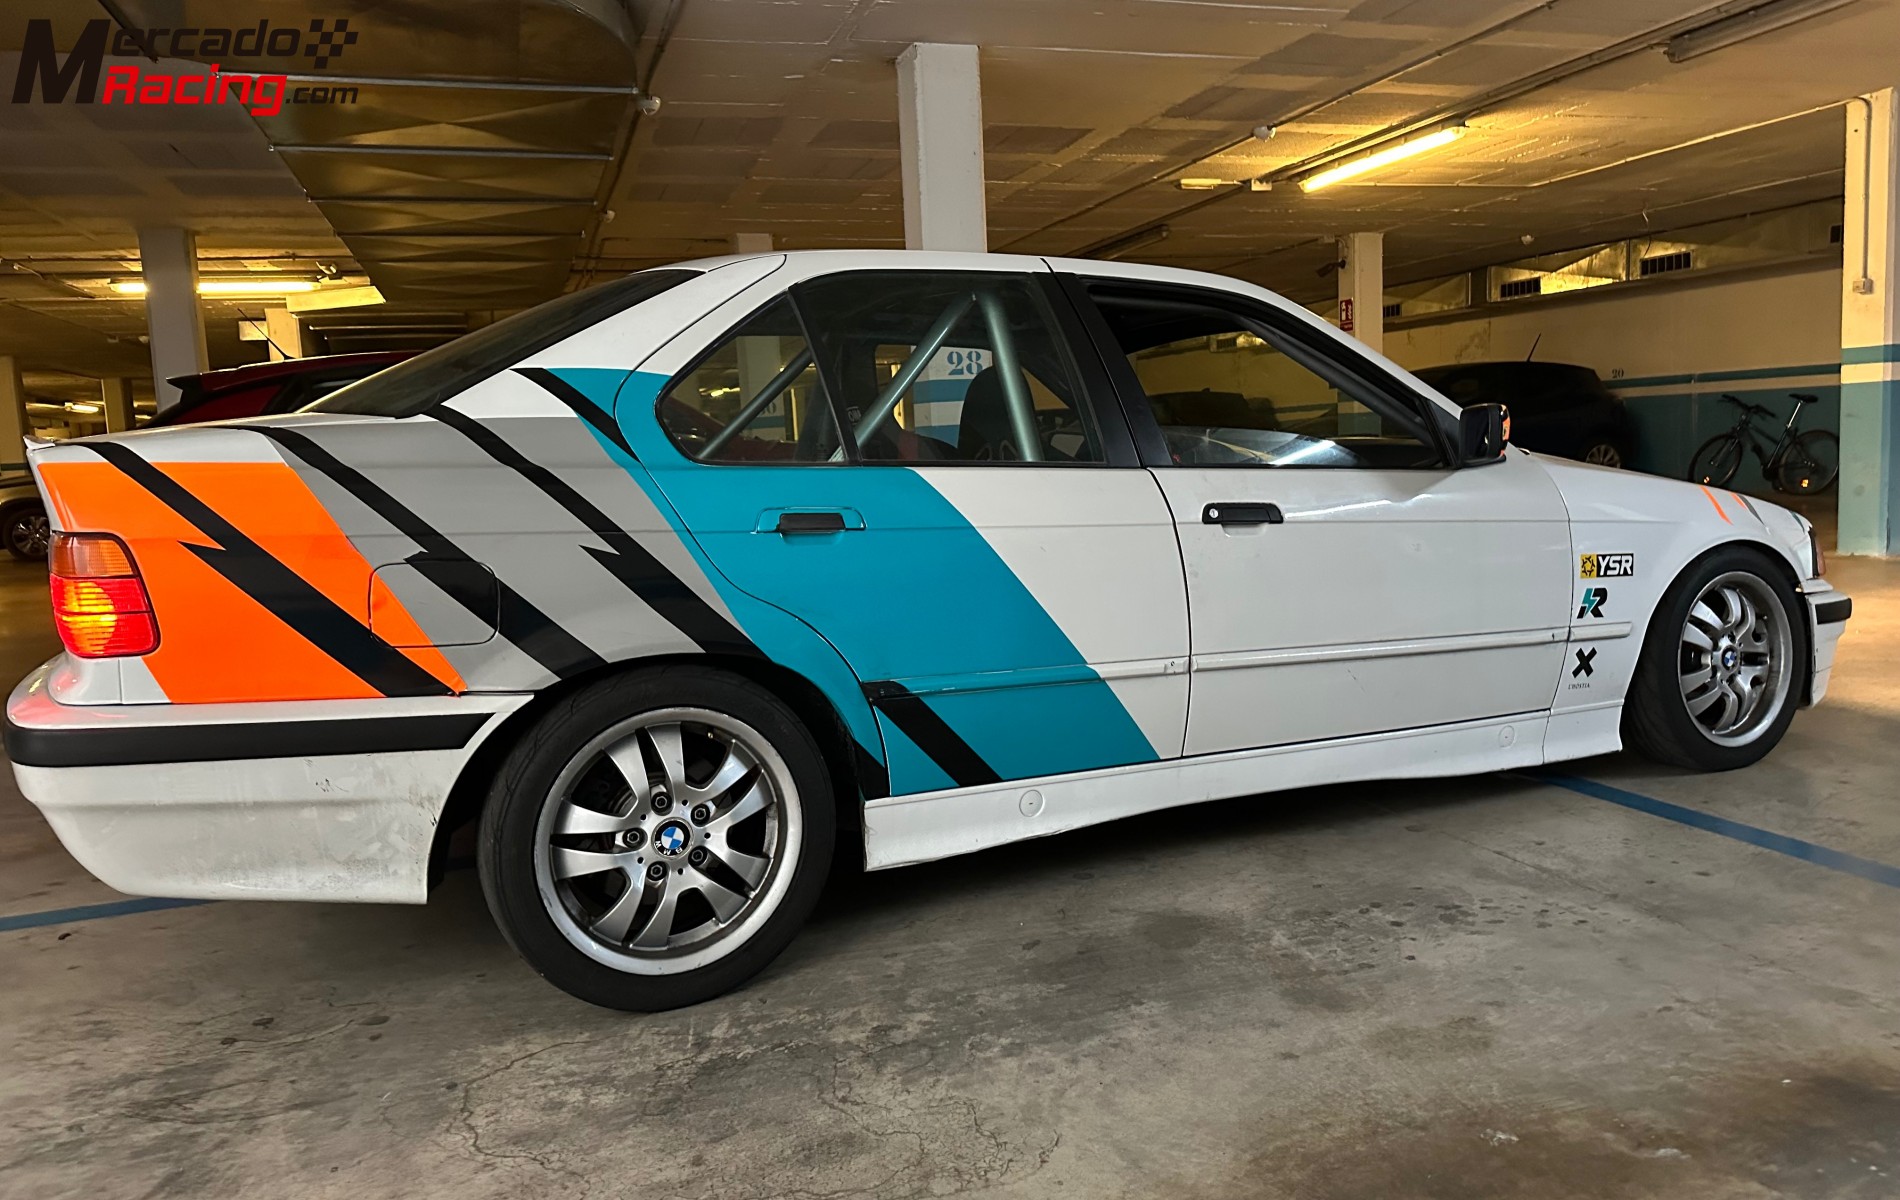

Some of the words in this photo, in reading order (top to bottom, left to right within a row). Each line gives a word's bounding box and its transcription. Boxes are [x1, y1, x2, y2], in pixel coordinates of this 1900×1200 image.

[947, 351, 983, 375] 28
[1611, 368, 1624, 379] 20
[1598, 555, 1633, 576] YSR
